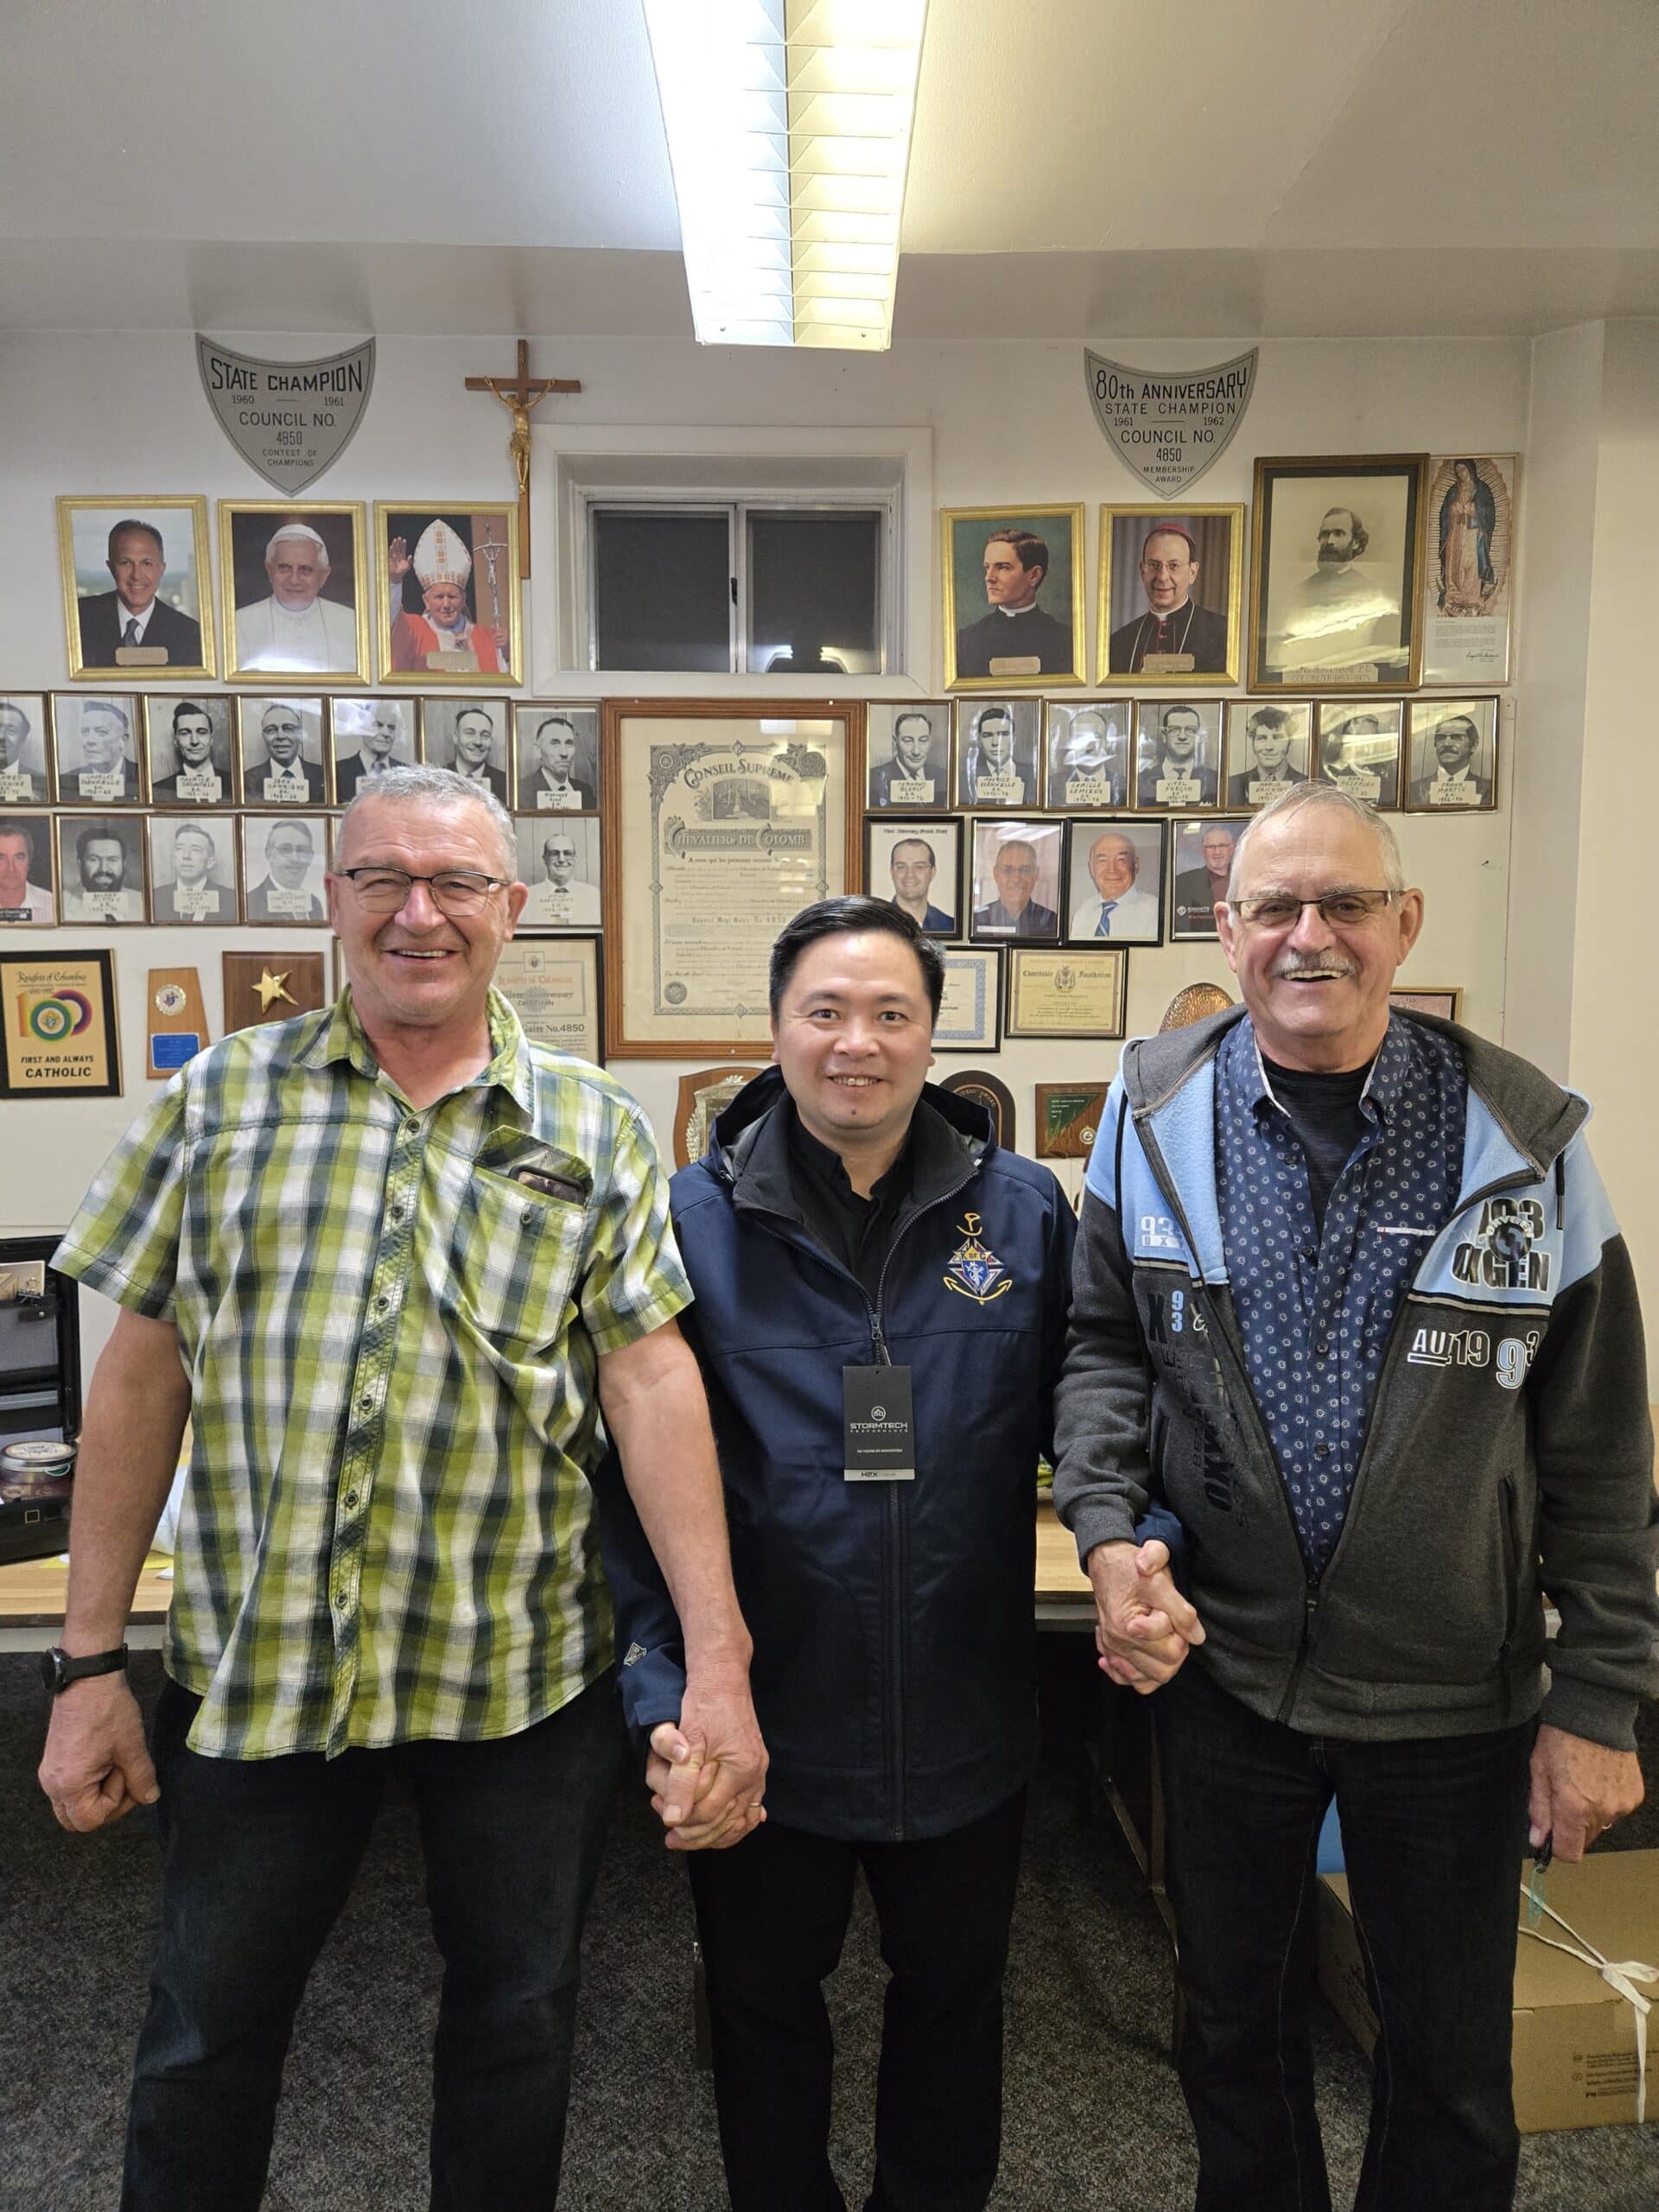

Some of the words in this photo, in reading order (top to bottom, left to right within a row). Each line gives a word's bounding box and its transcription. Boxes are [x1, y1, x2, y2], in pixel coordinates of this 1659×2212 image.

[211, 358, 257, 390] STATE
[268, 360, 362, 392] CHAMPION
[1096, 370, 1134, 399] 80th
[1141, 367, 1247, 399] ANNIVERSARY
[232, 395, 255, 404] 1960
[324, 397, 344, 406] 1961
[1105, 403, 1147, 414] STATE
[1158, 403, 1236, 414] CHAMPION
[239, 411, 308, 426] COUNCIL
[1114, 417, 1134, 427] 1961
[1204, 416, 1224, 426] 1962
[276, 431, 303, 445] 4850
[1121, 430, 1187, 443] COUNCIL
[1156, 448, 1182, 461] 4850
[26, 1067, 92, 1078] CATHOLIC
